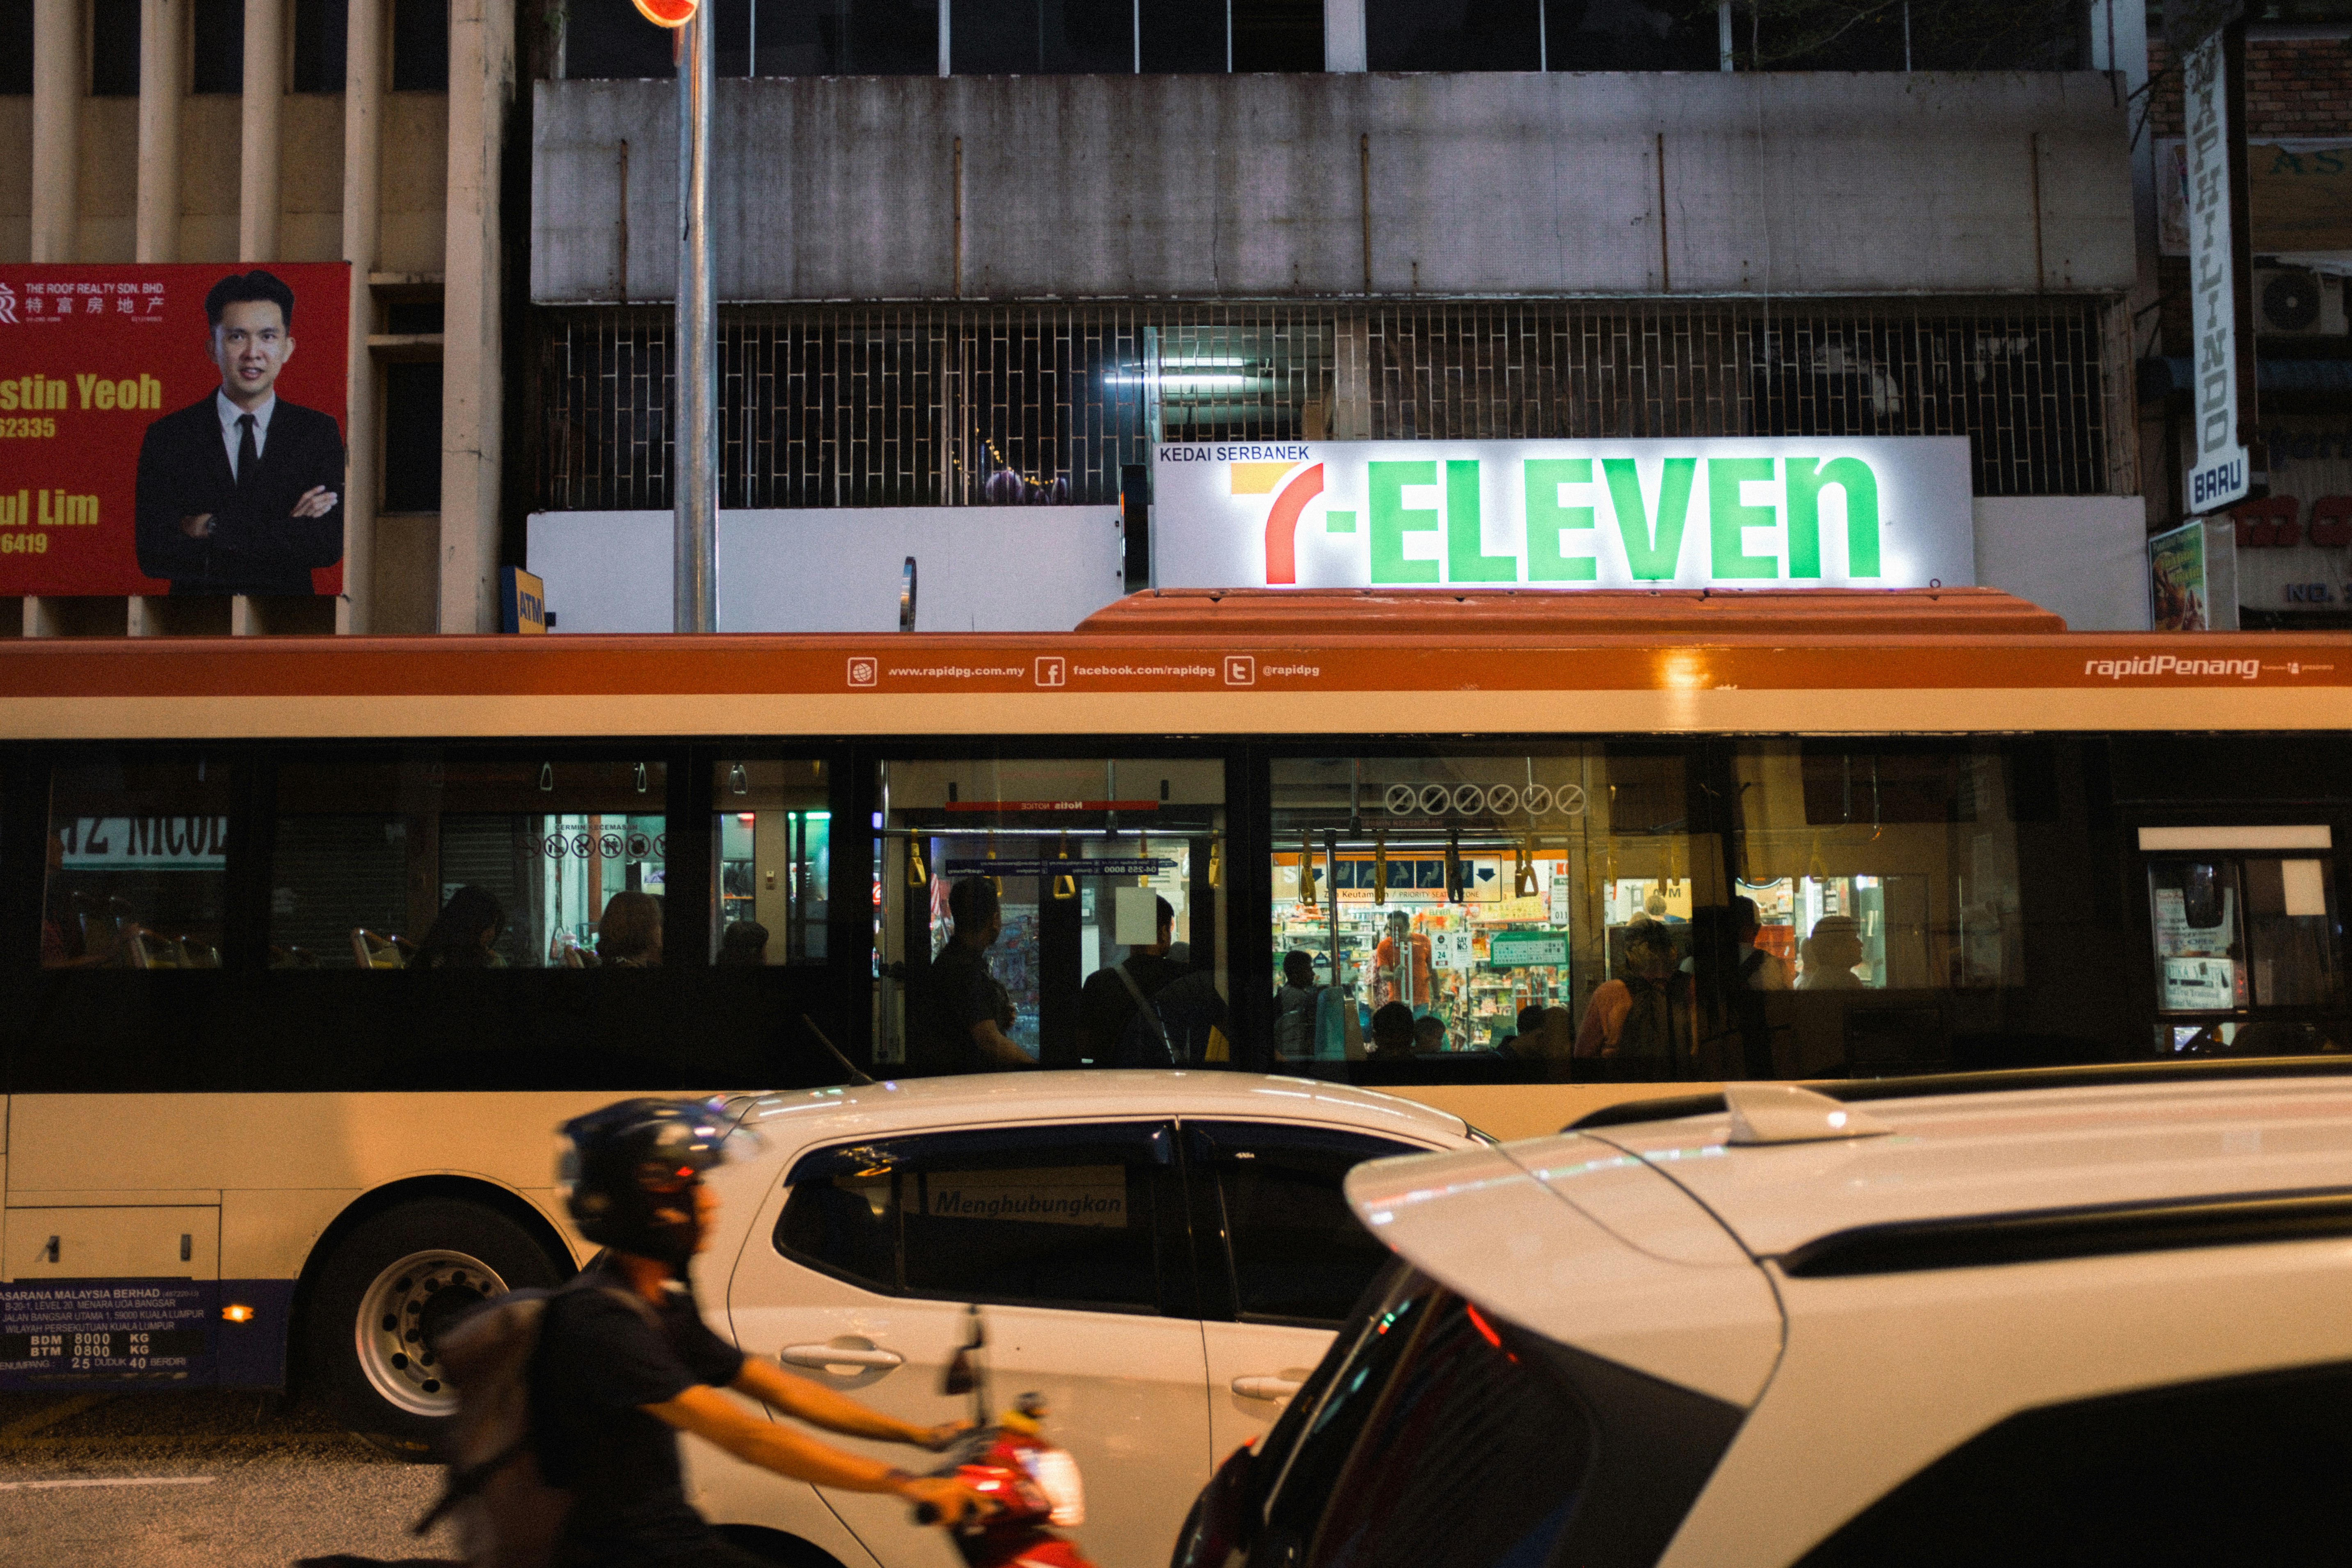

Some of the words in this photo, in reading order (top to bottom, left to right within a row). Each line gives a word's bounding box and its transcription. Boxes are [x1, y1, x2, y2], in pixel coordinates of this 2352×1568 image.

[25, 283, 44, 294] THE
[47, 283, 75, 294] ROOF
[77, 283, 115, 294] REALTY
[117, 283, 139, 294] SDN.
[25, 297, 164, 314] 特富房地产
[75, 373, 162, 410] Yeoh
[1160, 447, 1211, 462] KEDAI
[1216, 446, 1310, 461] SERBANEK
[2194, 459, 2242, 504] BARU
[37, 489, 99, 526] Lim
[520, 590, 543, 625] ATM
[888, 666, 1025, 677] www.rapidpg.com.my
[1073, 665, 1216, 677] facebook.com/rapidpg
[1262, 665, 1320, 677] @rapidpg
[2085, 655, 2259, 679] rapidPenang
[935, 1191, 1121, 1218] Menghubungkan
[54, 1289, 110, 1300] MALAYSIA
[113, 1288, 160, 1298] BERHAD
[35, 1301, 62, 1310] LEVEL
[77, 1300, 113, 1309] MENARA
[135, 1298, 176, 1308] BANGSAR
[2, 1313, 29, 1322] JALAN
[31, 1312, 72, 1322] BANGSAR
[74, 1312, 104, 1321] UTAMA
[139, 1310, 167, 1319] KUALA
[169, 1309, 204, 1319] LUMPUR
[5, 1324, 42, 1333] WILAYAH
[44, 1323, 108, 1333] PERSEKUTUAN
[110, 1322, 137, 1331] KUALA
[139, 1321, 175, 1331] LUMPUR
[31, 1335, 62, 1346] BDM
[74, 1333, 111, 1345] 8000
[129, 1333, 150, 1343] KG
[30, 1346, 62, 1357] BTM
[74, 1345, 110, 1357] 0800
[129, 1344, 149, 1355] KG
[71, 1357, 91, 1369] 25
[94, 1357, 127, 1367] DUDUK
[129, 1357, 146, 1369] 40
[149, 1356, 187, 1366] BERDIRI
